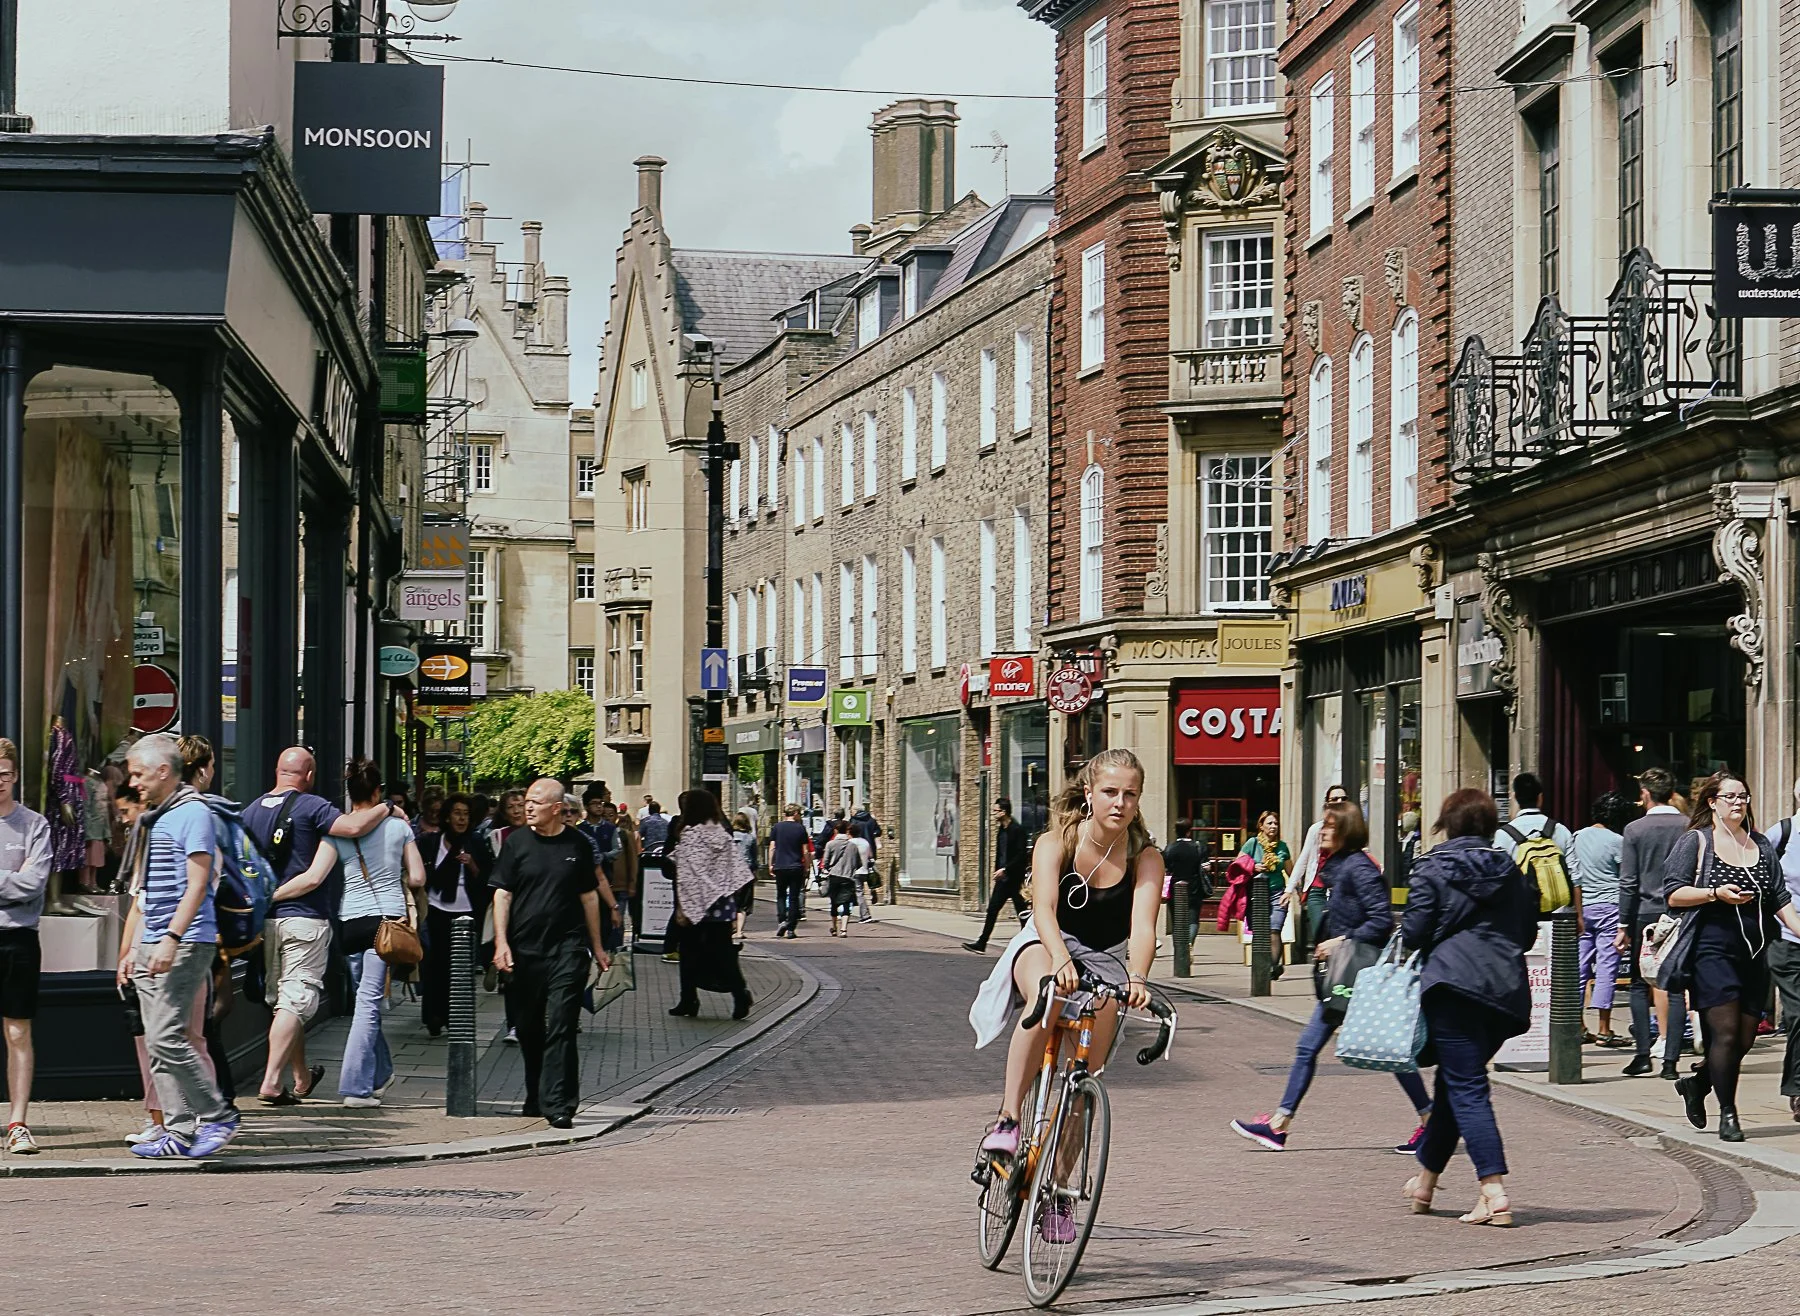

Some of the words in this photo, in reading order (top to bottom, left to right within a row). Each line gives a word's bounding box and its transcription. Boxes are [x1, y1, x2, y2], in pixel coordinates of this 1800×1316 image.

[304, 127, 431, 149] MONSOON
[406, 589, 461, 610] angels
[1224, 638, 1282, 650] JOULES
[1055, 671, 1084, 683] COSTA
[994, 682, 1031, 692] money
[1052, 695, 1088, 710] COFFEE
